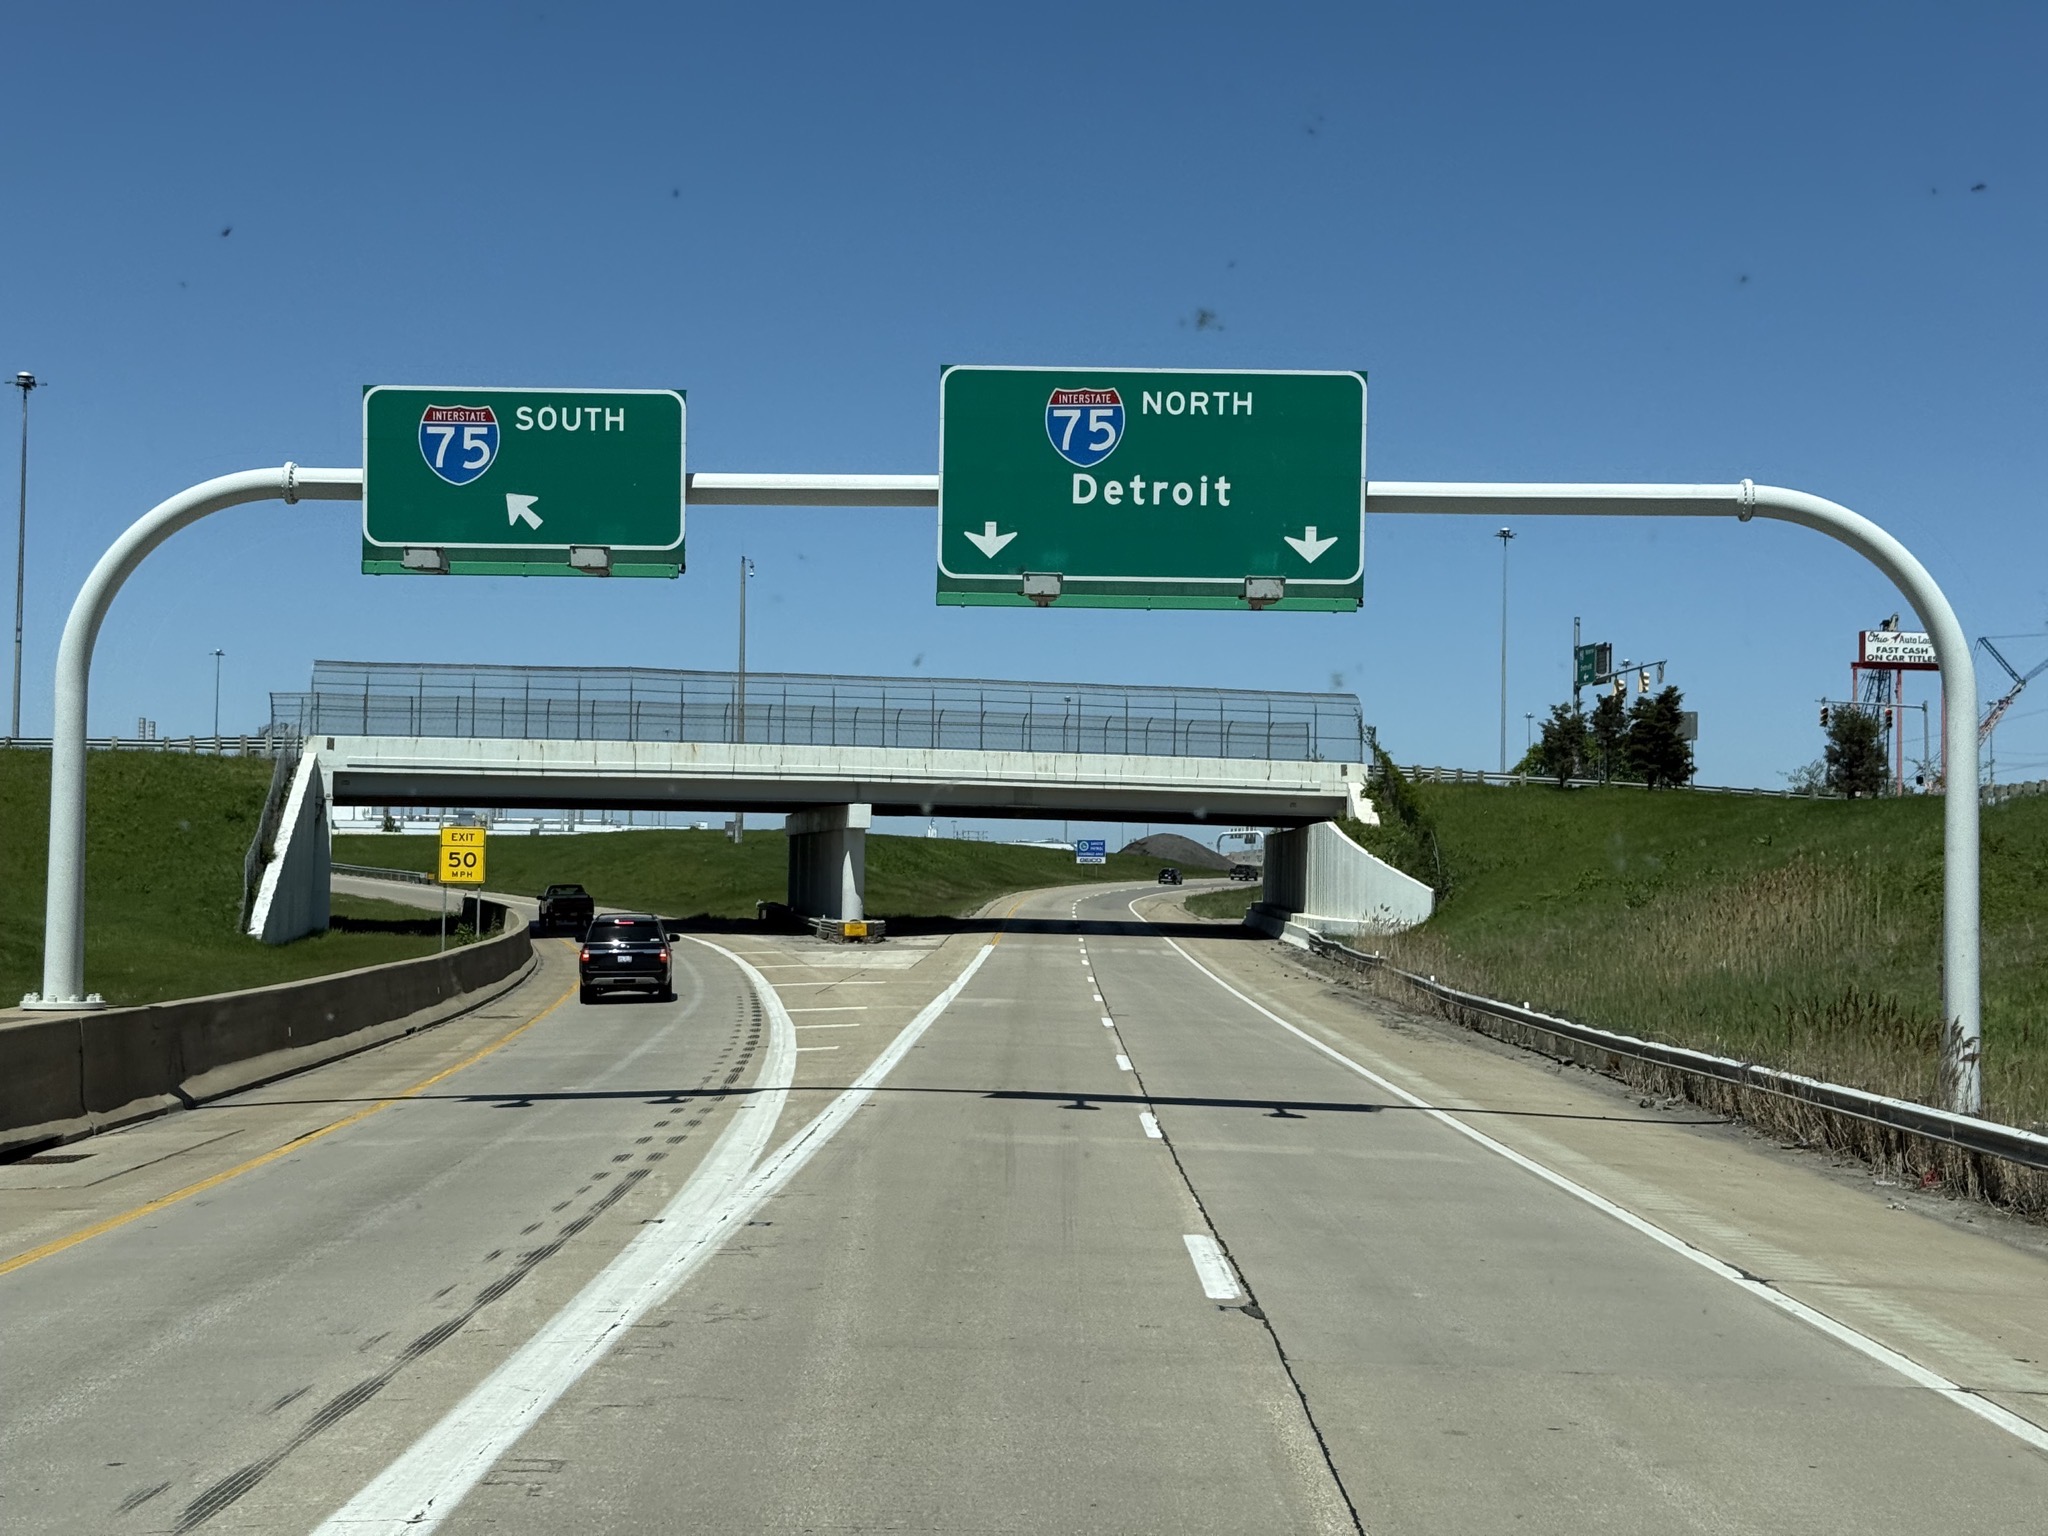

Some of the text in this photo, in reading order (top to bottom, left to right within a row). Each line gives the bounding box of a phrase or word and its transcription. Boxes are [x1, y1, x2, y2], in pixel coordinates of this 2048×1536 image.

[1058, 393, 1112, 404] INTERSTATE
[1142, 391, 1253, 415] NORTH
[432, 410, 487, 422] INTERSTATE
[515, 406, 625, 431] SOUTH
[1052, 408, 1116, 451] 75
[426, 426, 491, 469] 75
[1072, 473, 1231, 506] Detroit
[1867, 631, 1889, 643] Ohio
[1898, 635, 1917, 644] Auto
[451, 832, 475, 841] EXIT
[448, 851, 477, 868] 50
